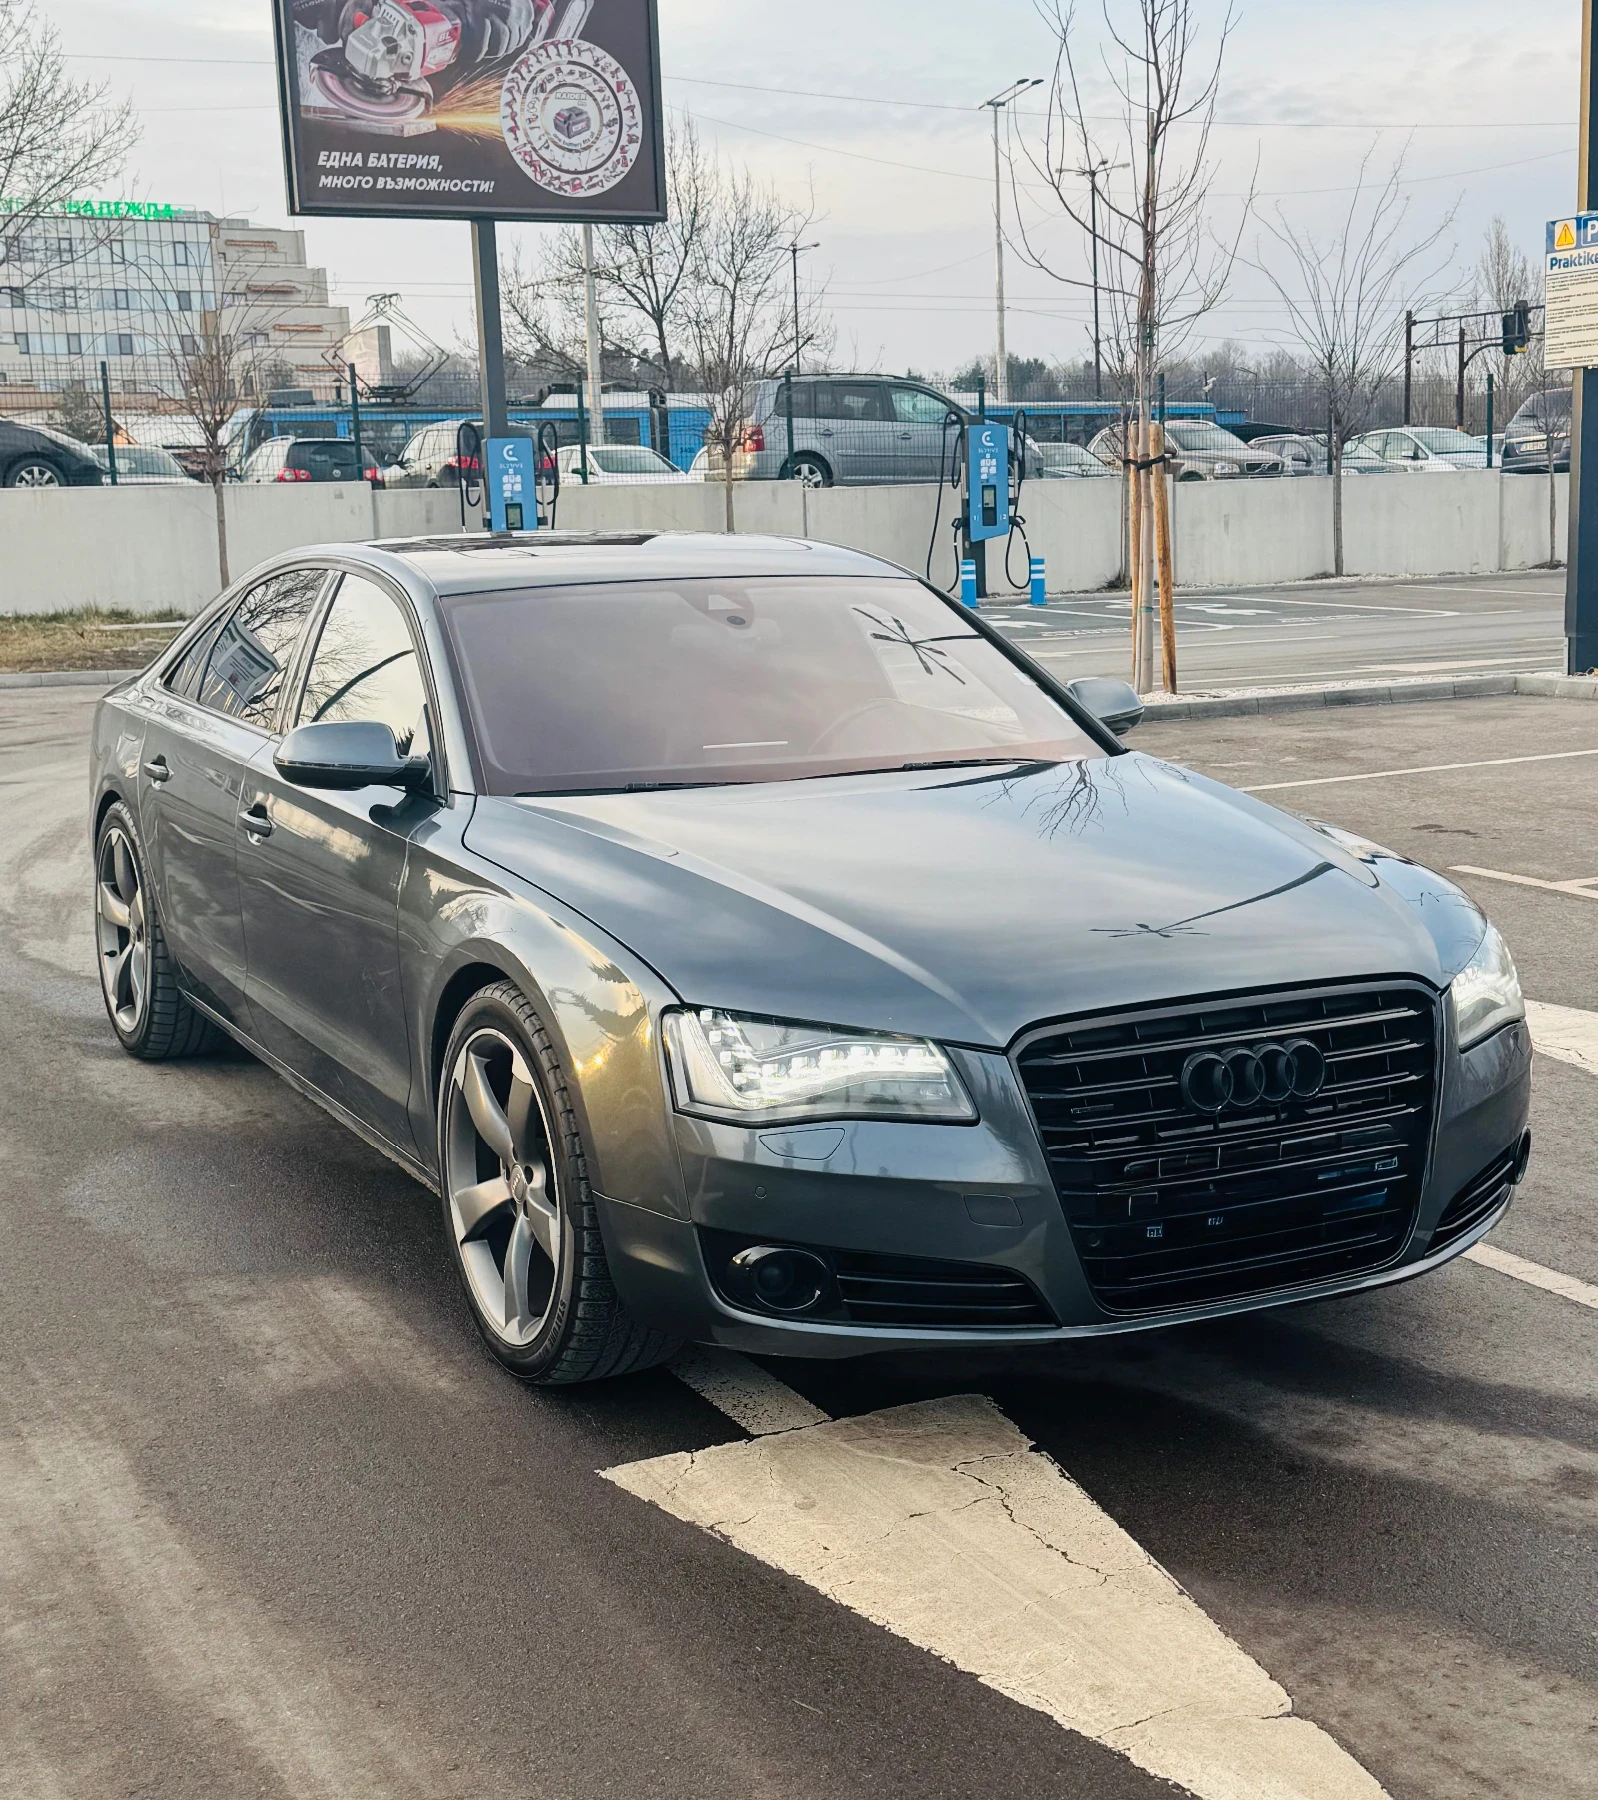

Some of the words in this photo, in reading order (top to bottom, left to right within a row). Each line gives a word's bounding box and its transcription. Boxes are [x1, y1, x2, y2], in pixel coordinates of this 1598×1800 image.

[555, 92, 587, 100] RAIDER
[317, 151, 363, 169] ЕДНА
[367, 152, 444, 173] БАТЕРИЯ,
[318, 175, 374, 189] МНОГО
[376, 176, 496, 193] ВЪЗМОЖНОСТИ!
[547, 1299, 567, 1347] STATURE
